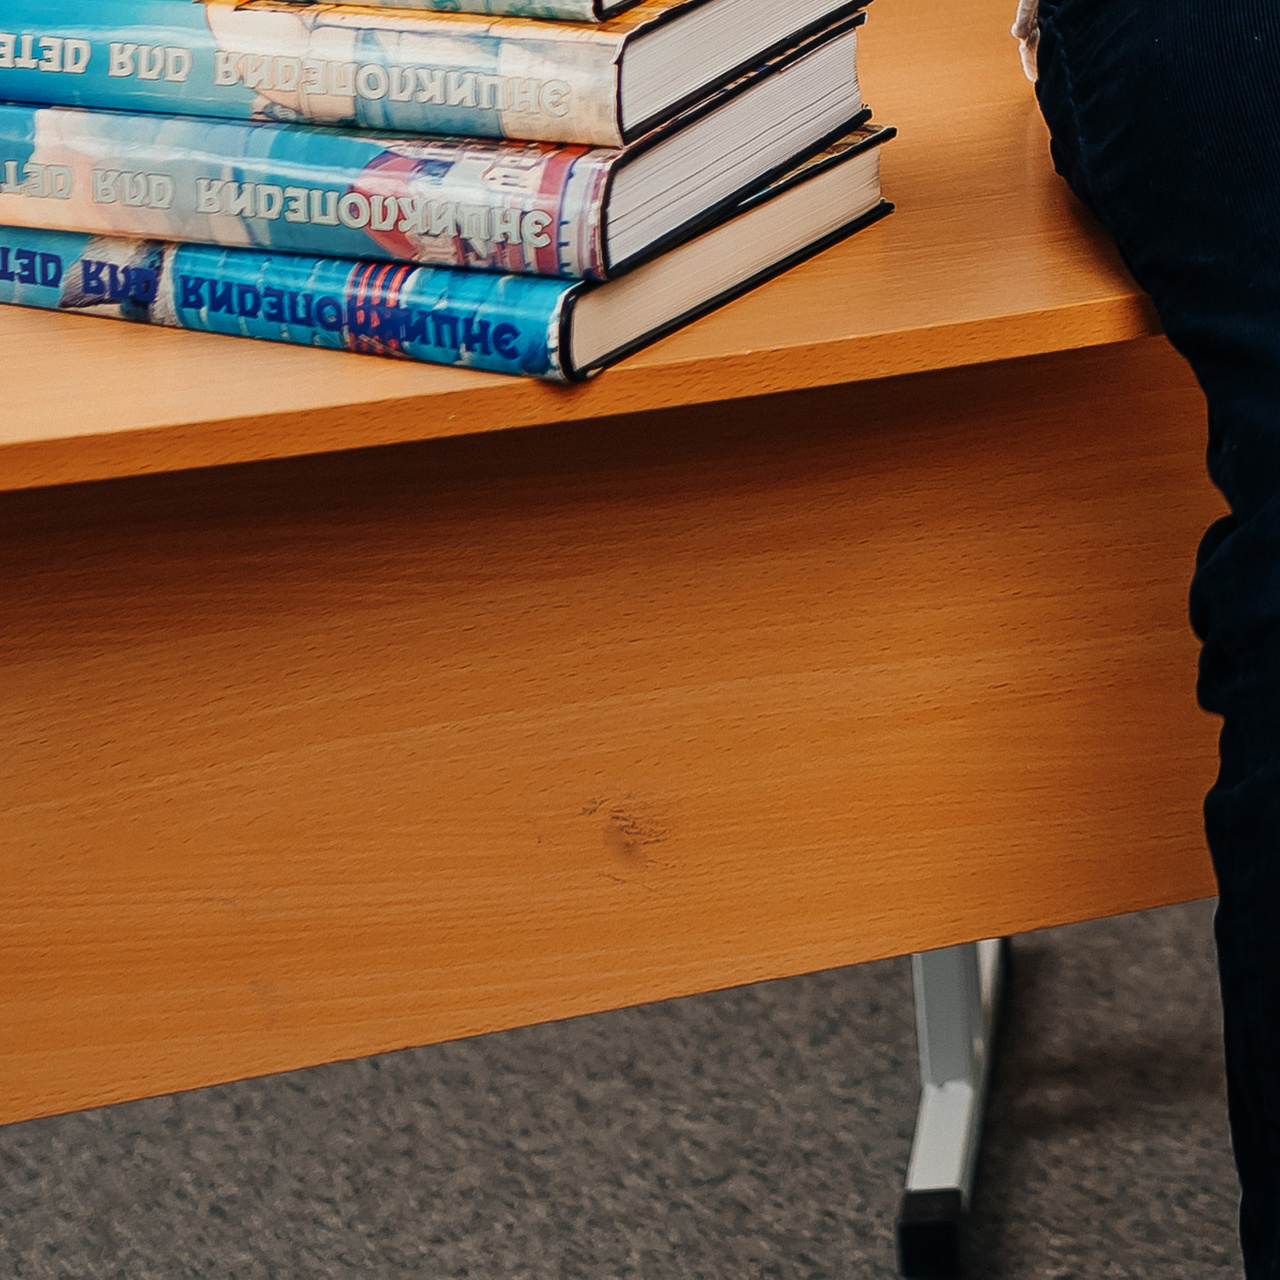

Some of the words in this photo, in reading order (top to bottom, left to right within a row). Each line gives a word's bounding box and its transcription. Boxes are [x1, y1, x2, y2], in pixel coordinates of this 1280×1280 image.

[107, 42, 193, 83] ДЛЯ
[213, 48, 570, 117] ЭНЦИКЛОПЕДИЯ
[92, 168, 176, 209] ДЛЯ
[195, 177, 554, 248] ЭНЦИКЛОПЕДИЯ
[80, 259, 158, 303] ДЛЯ
[178, 273, 523, 361] ЭНЦИКЛОПЕДИЯ
